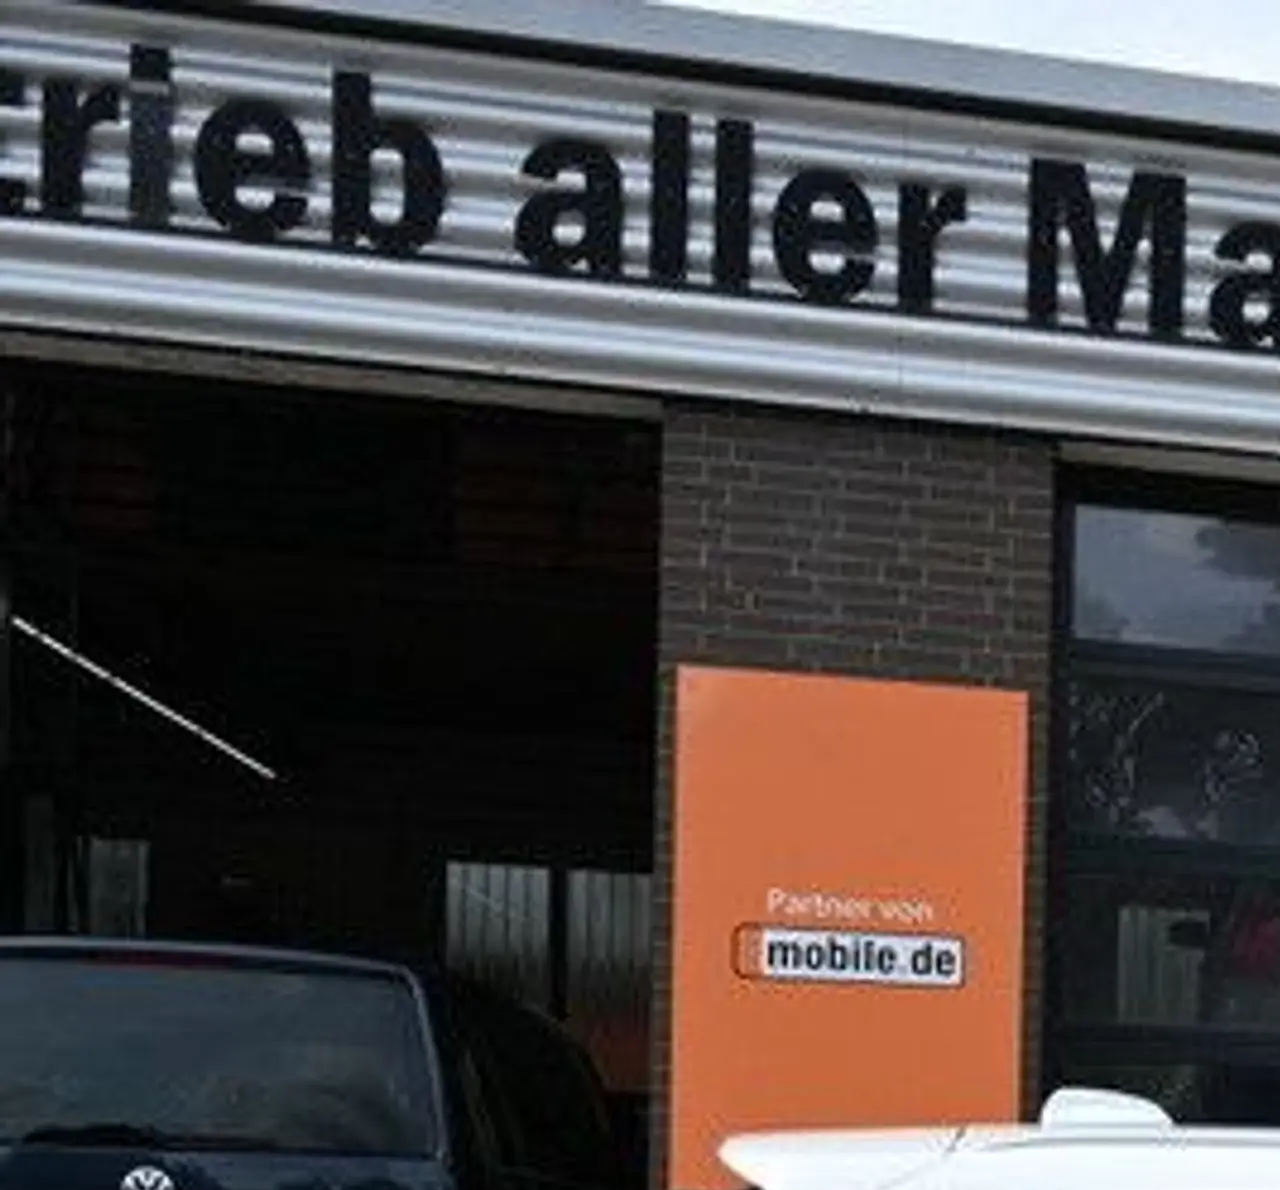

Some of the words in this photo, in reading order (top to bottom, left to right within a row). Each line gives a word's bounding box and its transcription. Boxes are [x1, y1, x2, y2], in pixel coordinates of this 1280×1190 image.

[513, 109, 967, 316] aller
[766, 887, 872, 921] Partner
[875, 896, 934, 925] von
[767, 937, 956, 976] mobile.de
